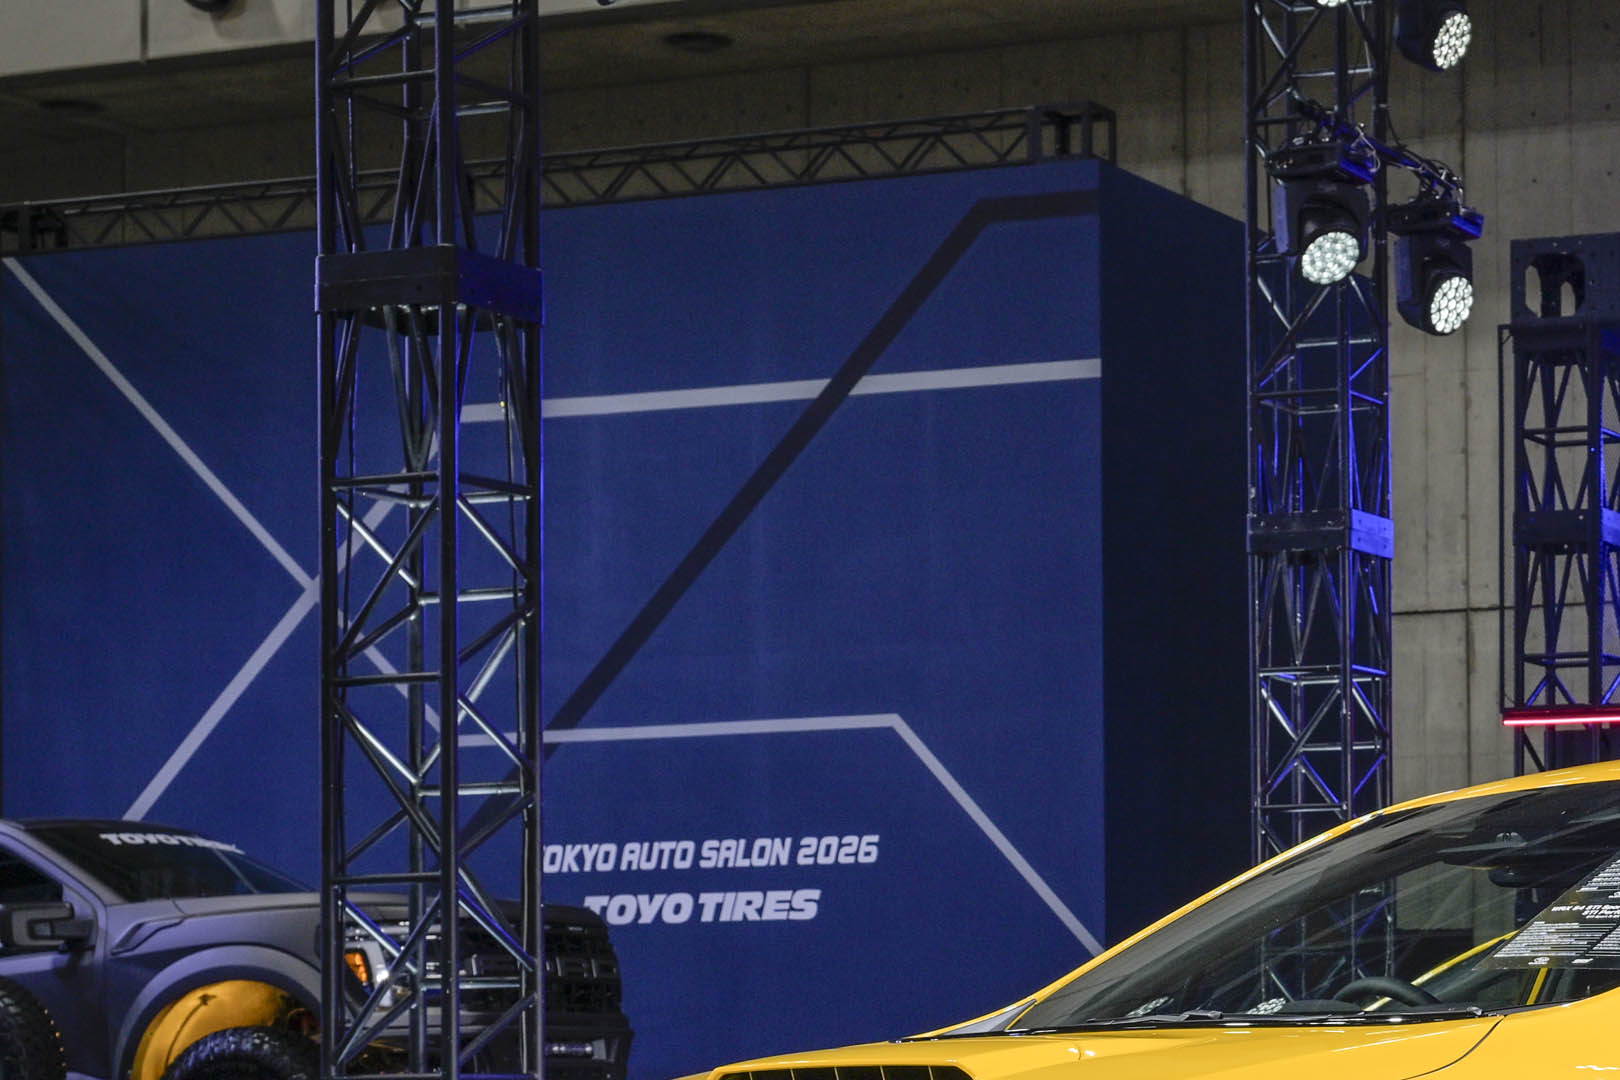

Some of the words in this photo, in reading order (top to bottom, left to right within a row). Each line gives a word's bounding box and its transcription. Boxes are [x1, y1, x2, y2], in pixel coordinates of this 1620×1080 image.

[542, 842, 618, 873] OKYO
[620, 841, 695, 871] AUTO
[699, 837, 792, 869] SALON
[796, 835, 880, 865] 2026
[584, 893, 697, 925] TOYO
[698, 889, 821, 922] TIRES
